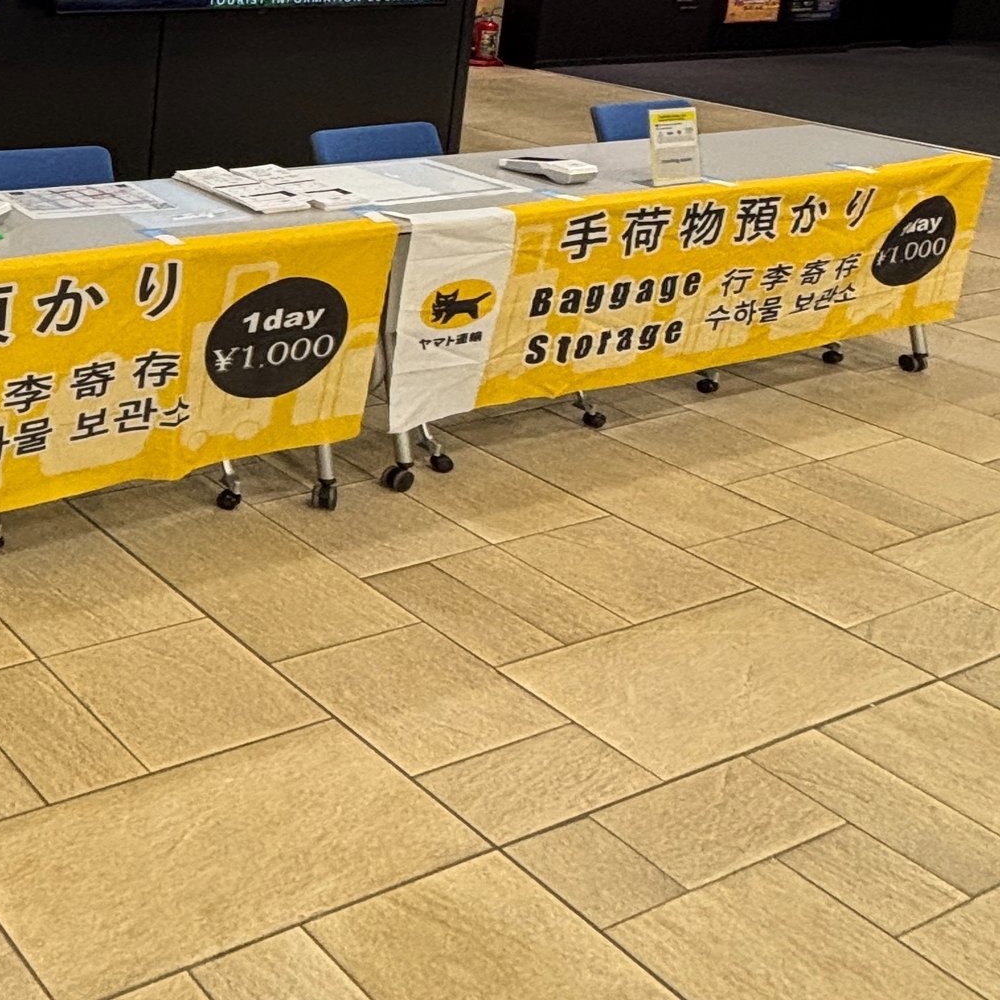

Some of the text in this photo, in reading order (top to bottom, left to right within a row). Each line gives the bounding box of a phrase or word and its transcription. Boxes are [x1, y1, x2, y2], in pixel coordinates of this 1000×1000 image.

[561, 187, 878, 262] 手荷物預かり
[529, 269, 702, 318] Baggage
[720, 255, 860, 295] 行李寄存
[241, 305, 326, 335] 1day
[705, 284, 858, 330] 수하물 보관소
[418, 330, 483, 350] ヤマト運輸
[525, 318, 683, 365] Storage
[75, 394, 191, 440] 보관소
